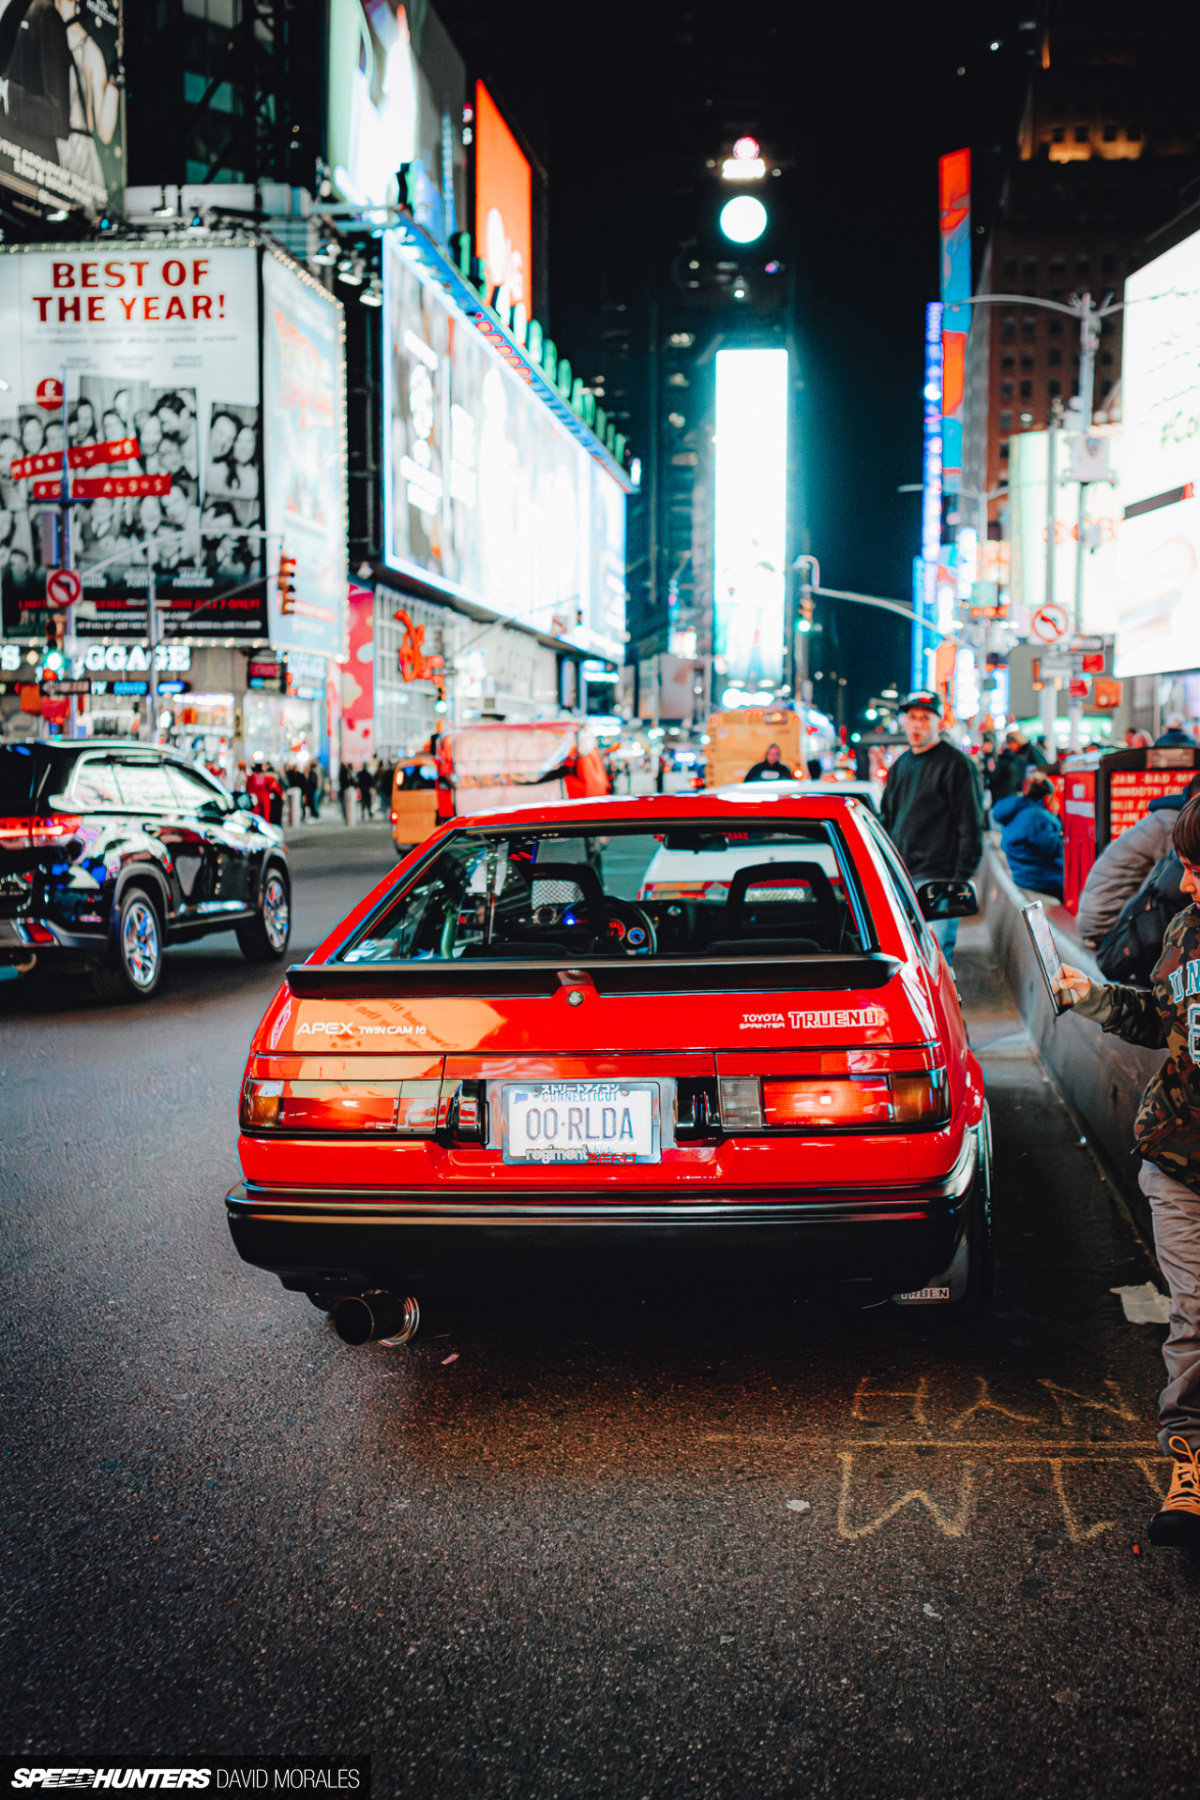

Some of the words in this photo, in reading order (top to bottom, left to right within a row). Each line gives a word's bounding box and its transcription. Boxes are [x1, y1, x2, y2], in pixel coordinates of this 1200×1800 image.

[52, 261, 150, 288] BEST
[161, 259, 210, 287] OF
[32, 295, 106, 322] THE
[119, 294, 225, 321] YEAR!
[739, 1022, 786, 1030] SPRINTER
[742, 1013, 785, 1023] TOYOTA
[788, 1008, 879, 1029] TRUENO
[296, 1022, 354, 1035] APEX
[358, 1026, 386, 1035] TWIN
[387, 1026, 412, 1035] CAM
[416, 1026, 427, 1035] 16
[525, 1144, 589, 1165] regiment
[586, 1153, 637, 1165] ZERO
